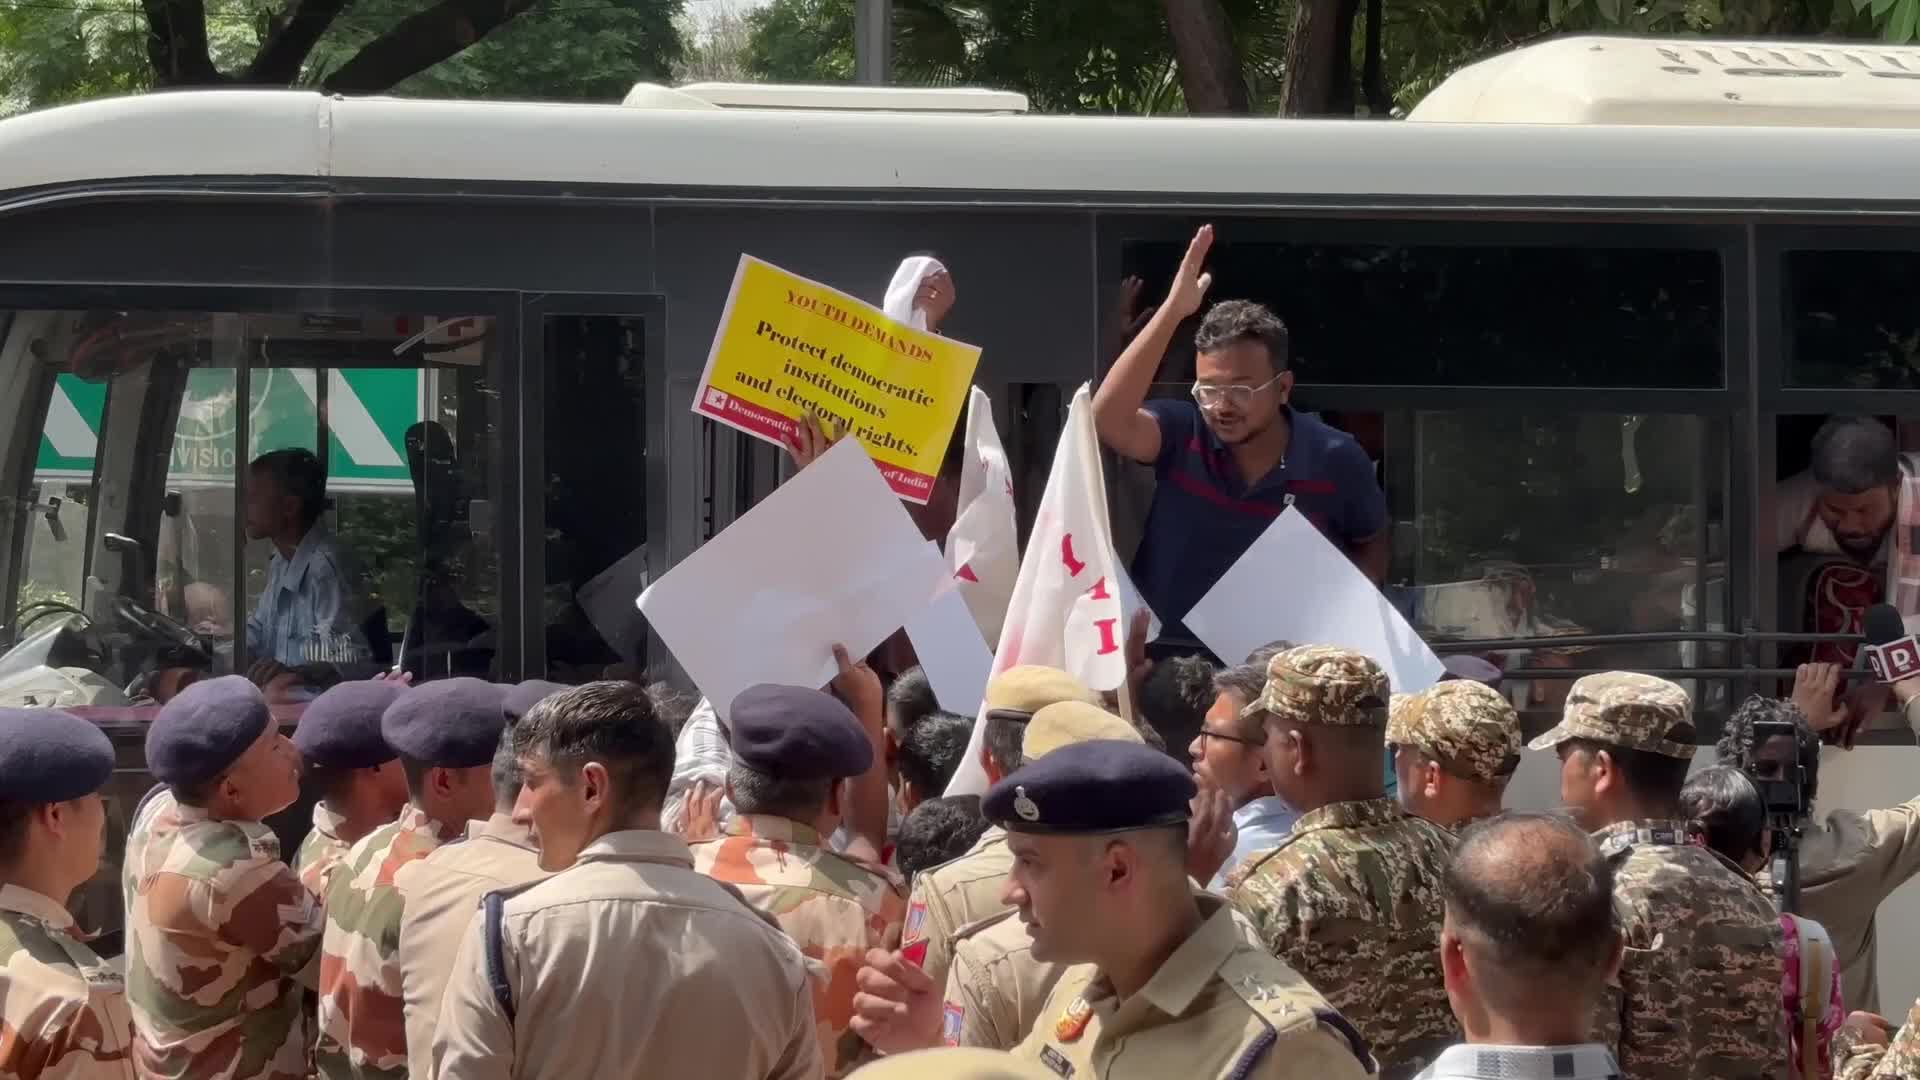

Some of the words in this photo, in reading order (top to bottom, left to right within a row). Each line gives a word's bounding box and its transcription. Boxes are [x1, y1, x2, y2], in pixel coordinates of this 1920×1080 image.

[785, 289, 847, 324] YOUTH
[849, 313, 934, 361] DEMANDS
[756, 319, 827, 360] Protect
[831, 353, 935, 407] democratic
[784, 359, 887, 418] institutions
[728, 399, 792, 433] Democratic
[735, 370, 772, 394] and
[776, 385, 854, 432] electoral
[856, 422, 918, 457] rights.
[885, 469, 896, 481] of
[895, 471, 928, 490] India
